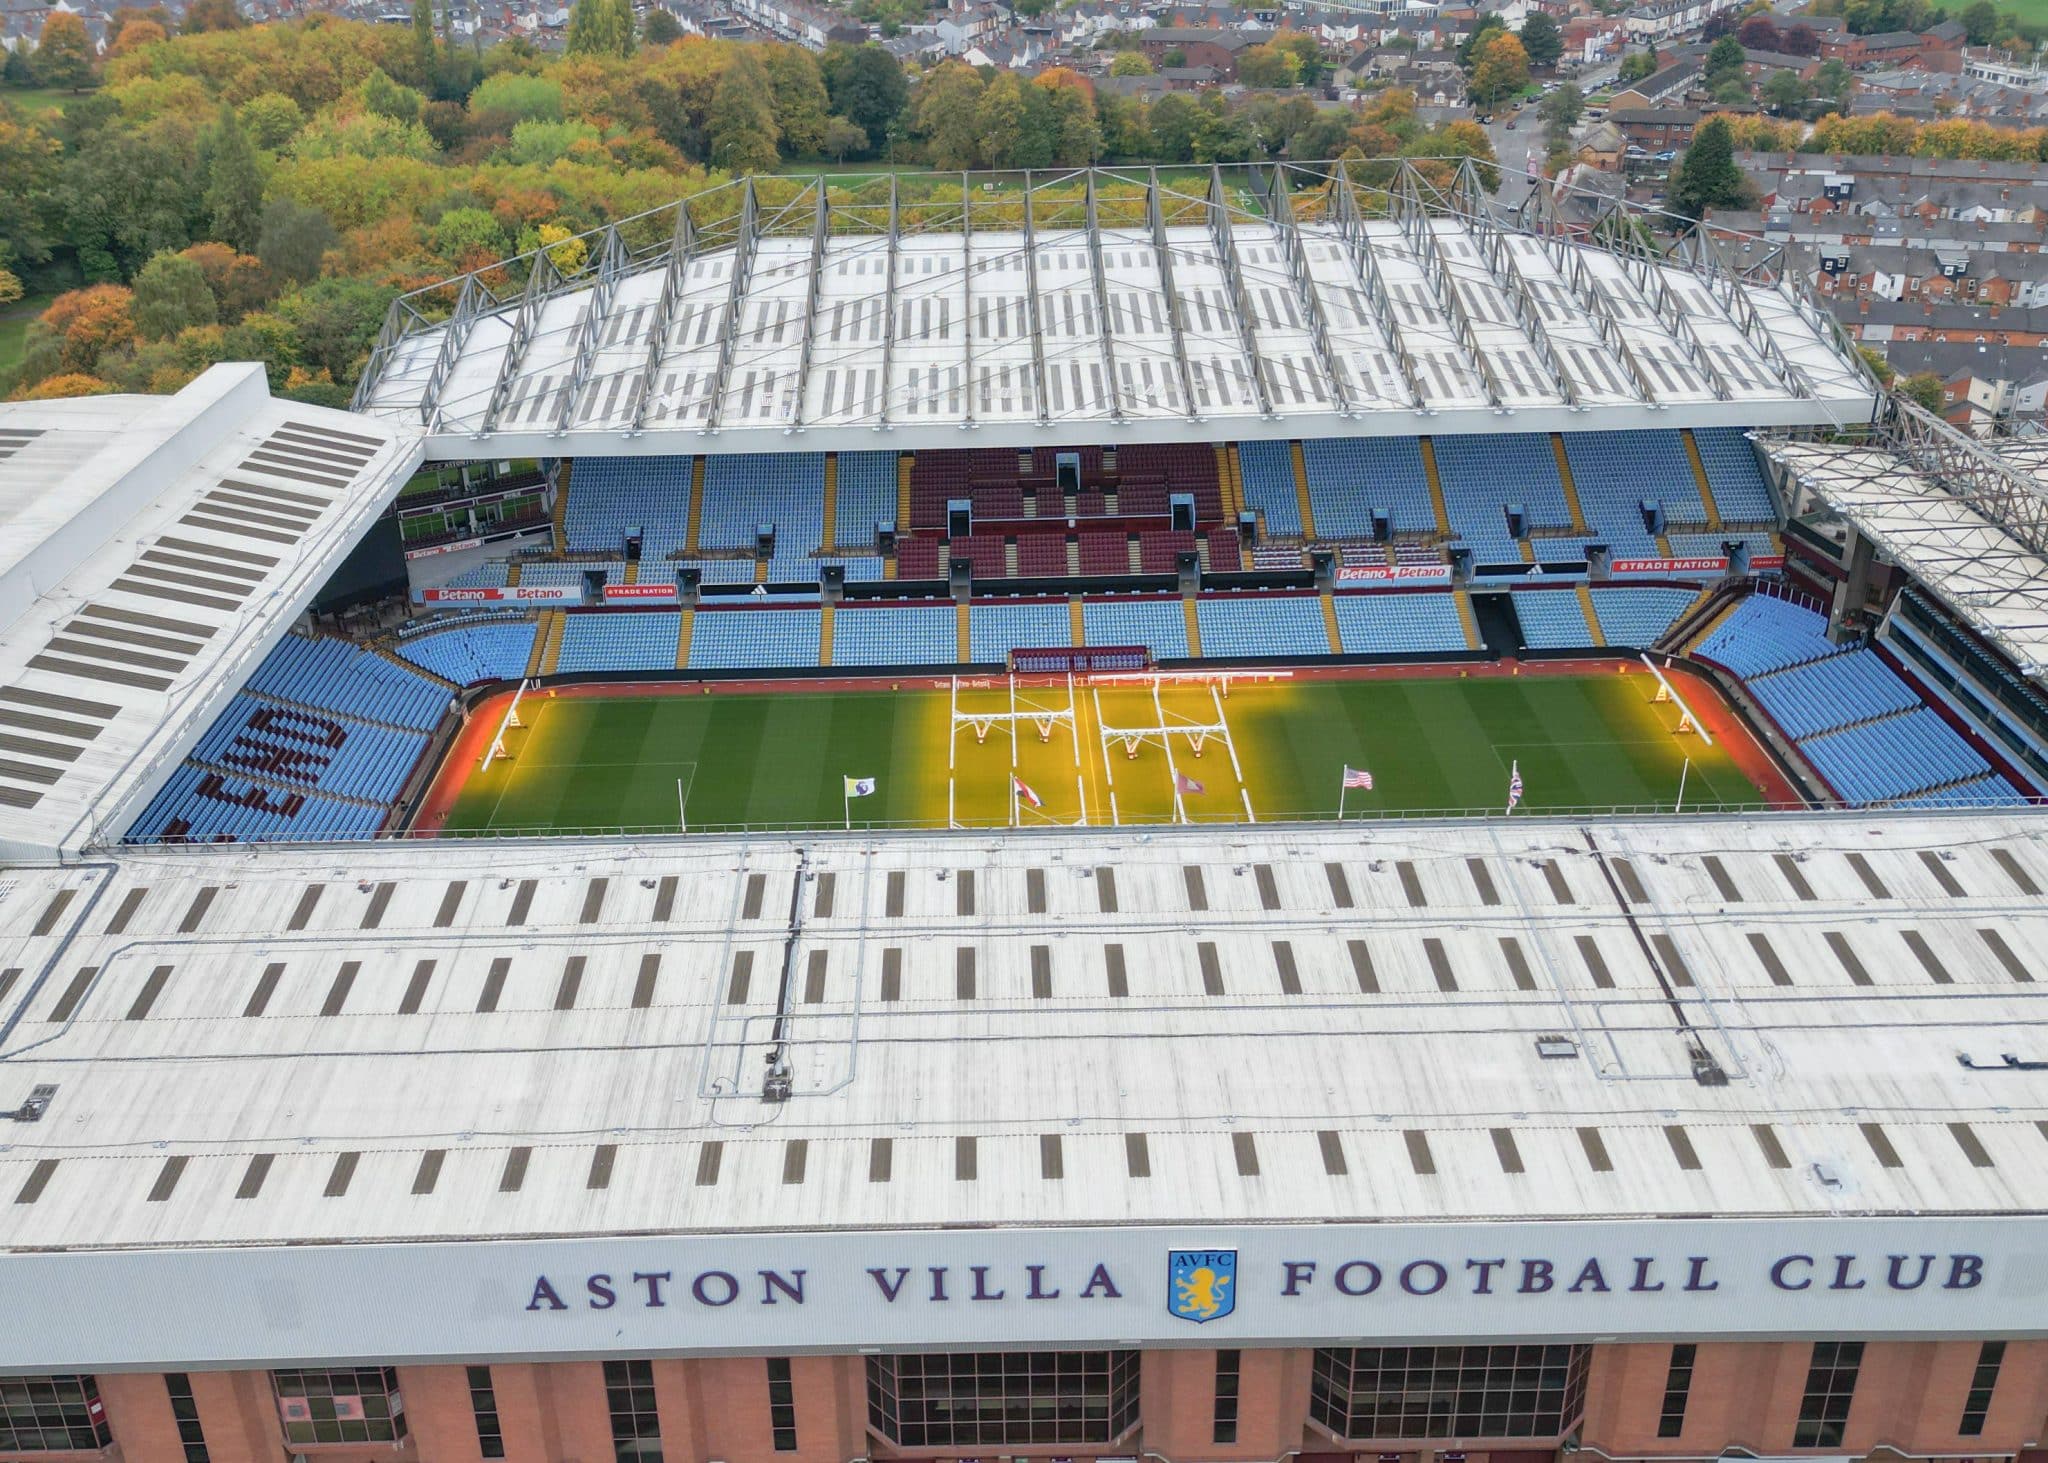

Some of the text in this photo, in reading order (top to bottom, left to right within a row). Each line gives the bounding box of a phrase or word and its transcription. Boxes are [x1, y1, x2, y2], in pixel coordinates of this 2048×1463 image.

[1629, 560, 1720, 570] TRADE NATION
[1339, 568, 1388, 580] Betano
[1399, 567, 1445, 578] Betano
[438, 590, 485, 600] Betano
[517, 588, 563, 599] Betano
[1174, 1254, 1232, 1267] AVFC
[525, 1254, 1986, 1311] ASTON VILLA FOOTBALL CLUB
